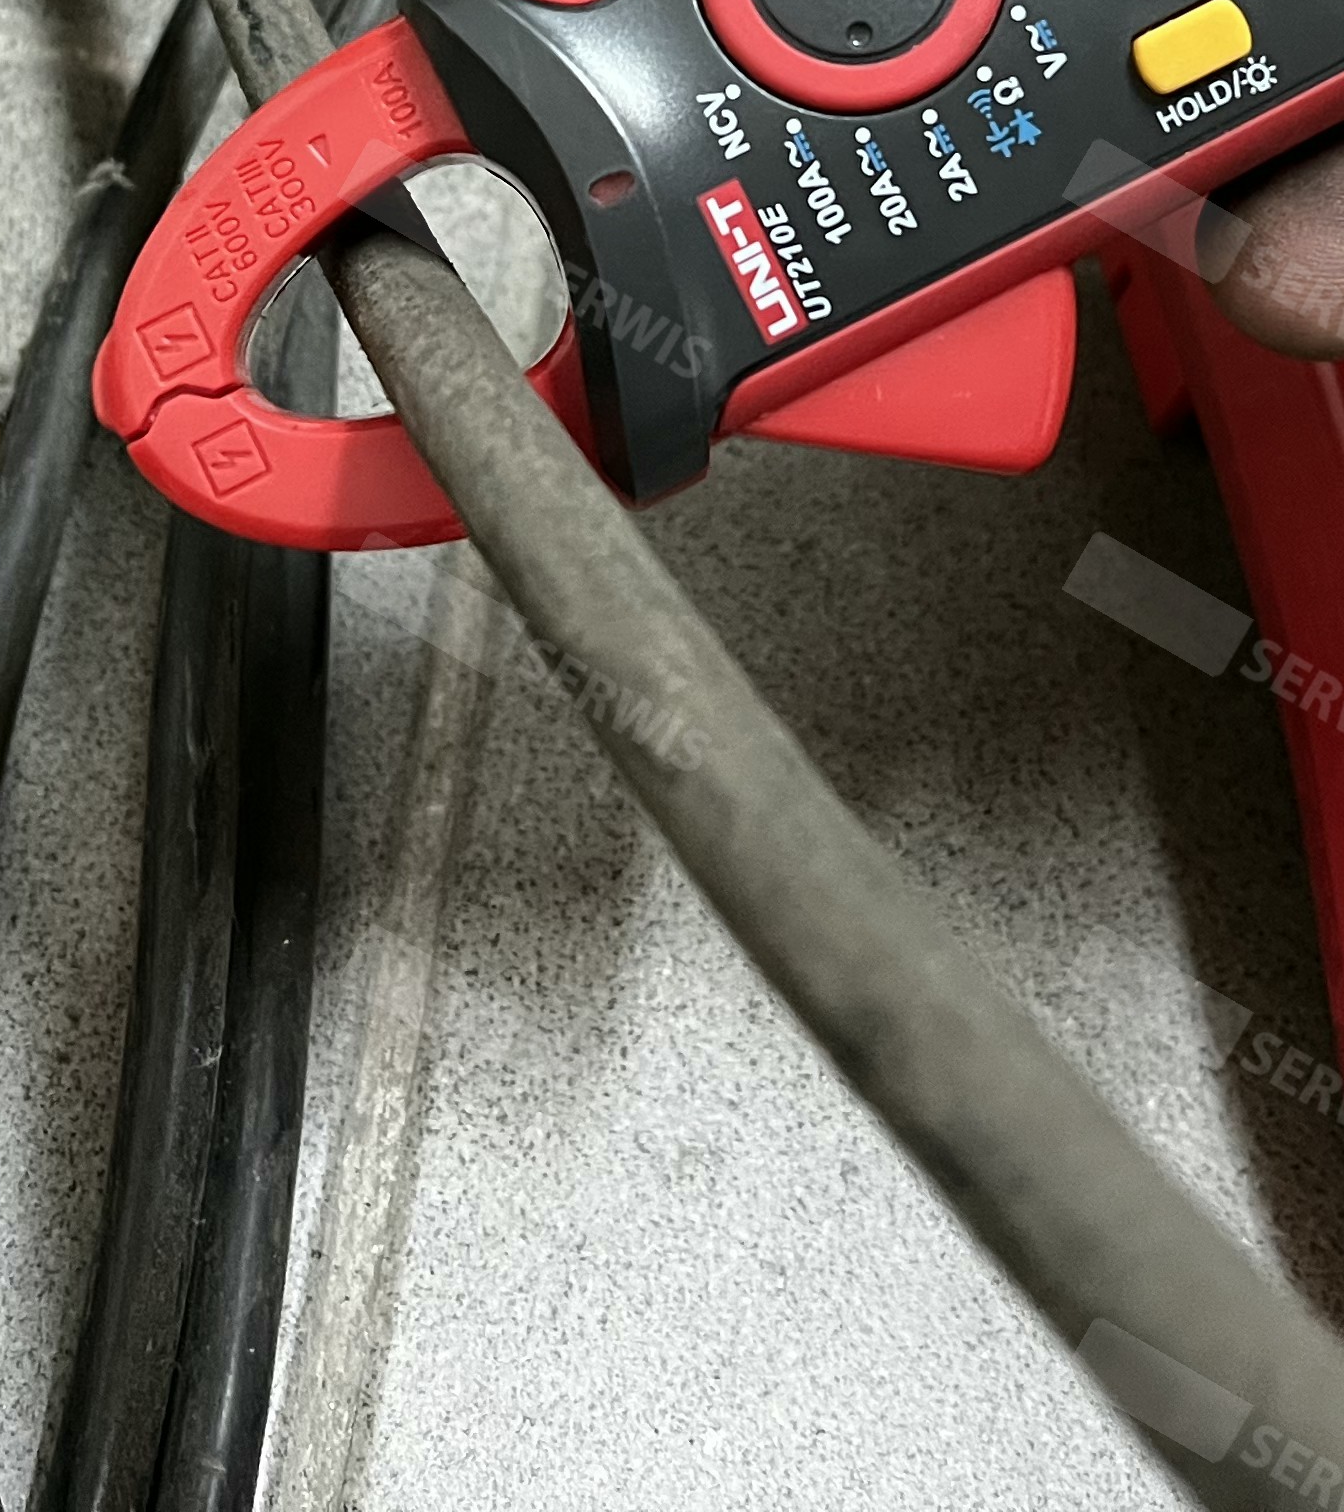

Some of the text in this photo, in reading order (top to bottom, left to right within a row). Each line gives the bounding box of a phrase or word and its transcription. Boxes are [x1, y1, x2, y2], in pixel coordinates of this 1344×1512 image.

[373, 60, 424, 139] 100A
[696, 90, 751, 160] NCV
[258, 137, 317, 221] 300V
[205, 200, 259, 272] 600V
[705, 197, 799, 337] UNI-T
[757, 203, 832, 321] UT210E
